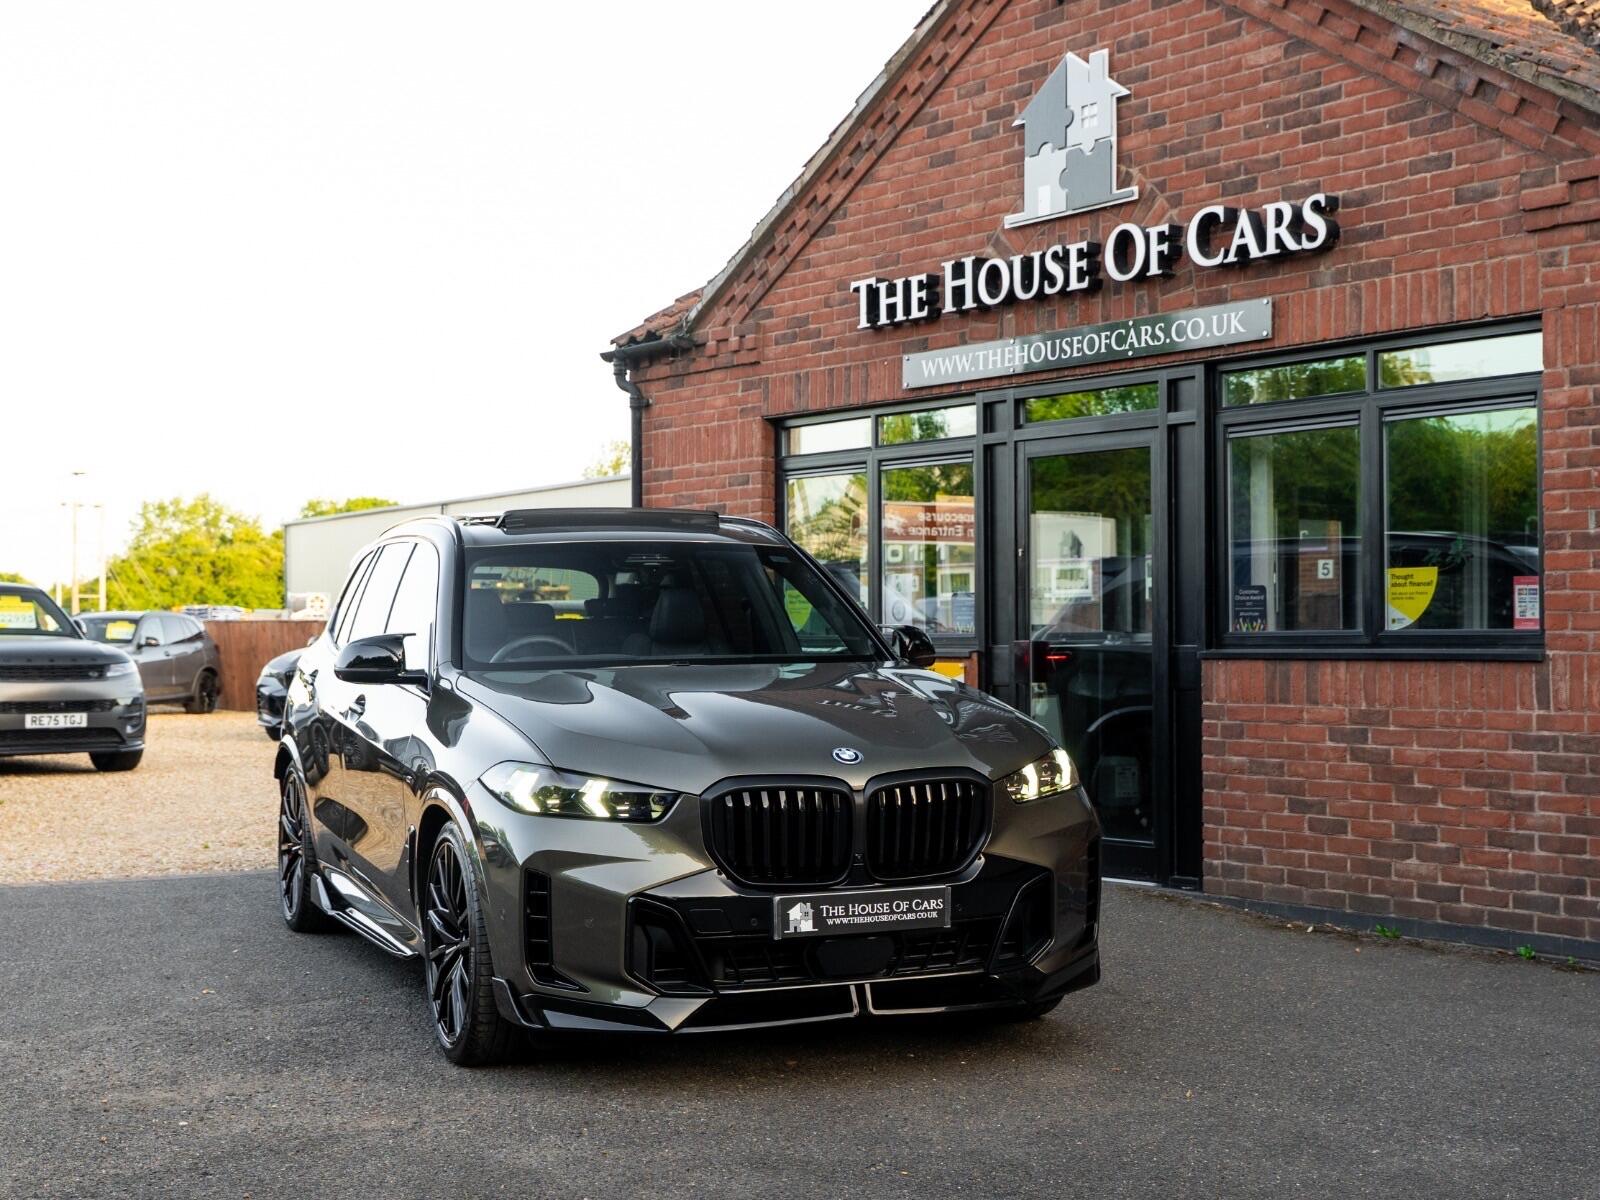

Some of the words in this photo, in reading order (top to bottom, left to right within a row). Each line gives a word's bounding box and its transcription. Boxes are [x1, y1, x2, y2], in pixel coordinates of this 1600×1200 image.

[850, 272, 929, 329] THE
[941, 241, 1091, 314] HOUSE
[1104, 222, 1171, 282] OF
[1185, 193, 1329, 267] CARS
[921, 311, 1246, 379] WWW.THEHOUSEOFCARS.CO.UK
[1321, 562, 1330, 577] 5
[31, 715, 60, 726] RE75
[63, 714, 83, 725] TGJ
[819, 905, 845, 917] THE
[849, 903, 890, 915] HOUSE
[893, 900, 910, 912] OF
[912, 899, 944, 911] CARS
